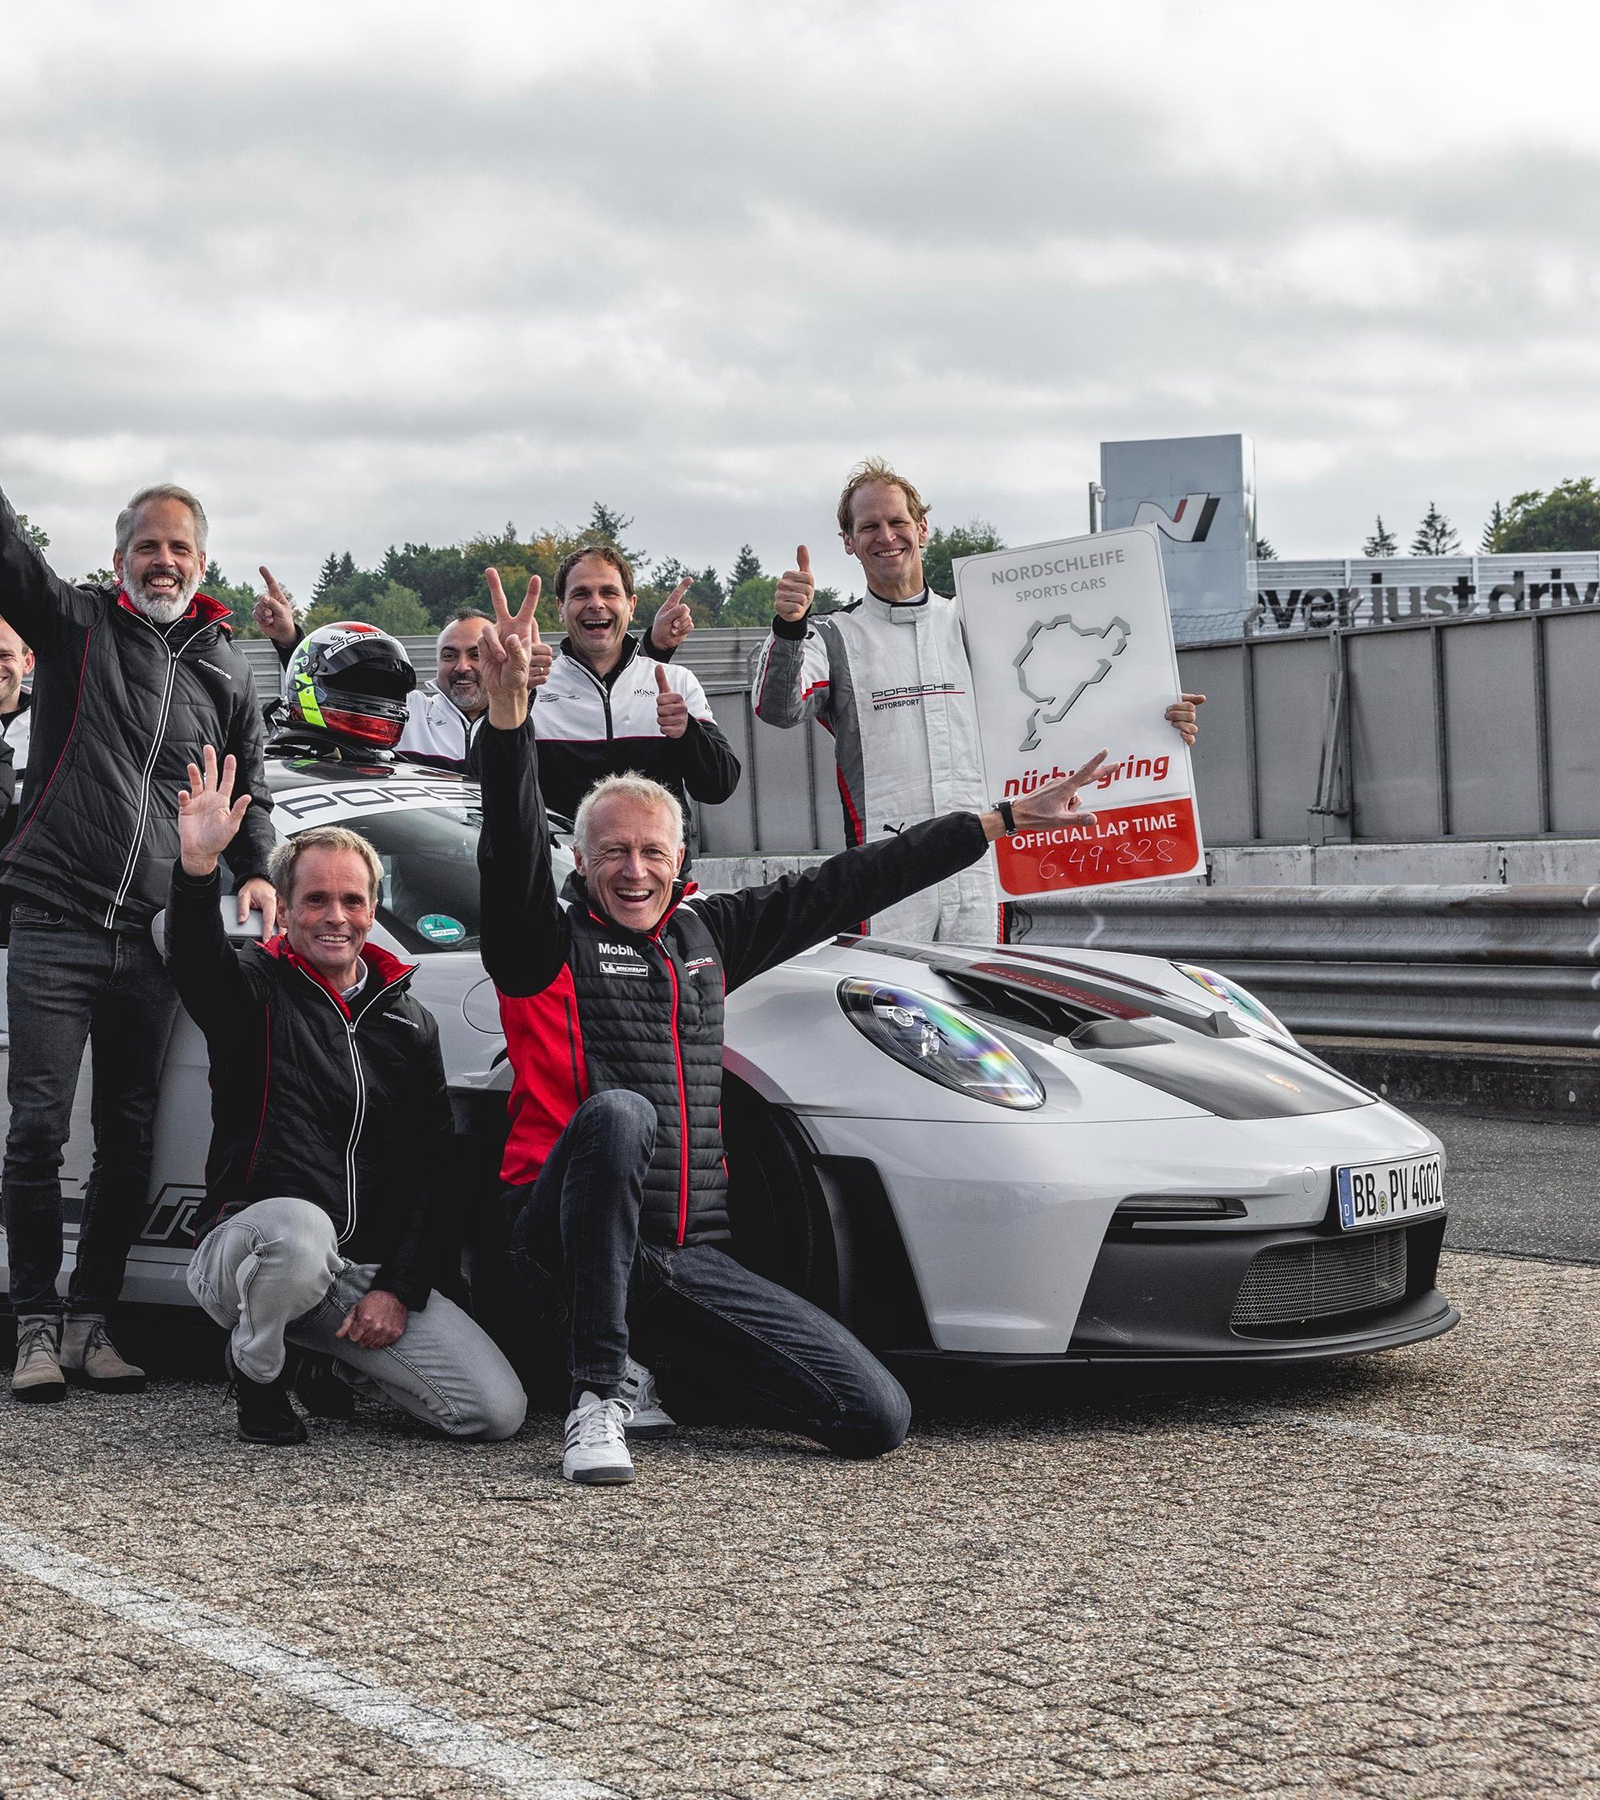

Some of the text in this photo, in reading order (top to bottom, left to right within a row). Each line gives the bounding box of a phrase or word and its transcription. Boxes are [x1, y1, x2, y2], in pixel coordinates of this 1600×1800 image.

[991, 549, 1125, 585] NORDSCHLEIFE
[1016, 576, 1107, 603] SPORTS CARS
[1258, 588, 1359, 629] ver
[198, 659, 232, 680] PORSCHE
[871, 683, 955, 699] PORSCHE
[873, 699, 920, 711] MOTORSPORT
[1011, 813, 1177, 850] OFFICIAL LAP TIME
[382, 1011, 419, 1029] PORSCHE
[1352, 1161, 1441, 1218] BB PV 4002
[1344, 1203, 1350, 1217] D
